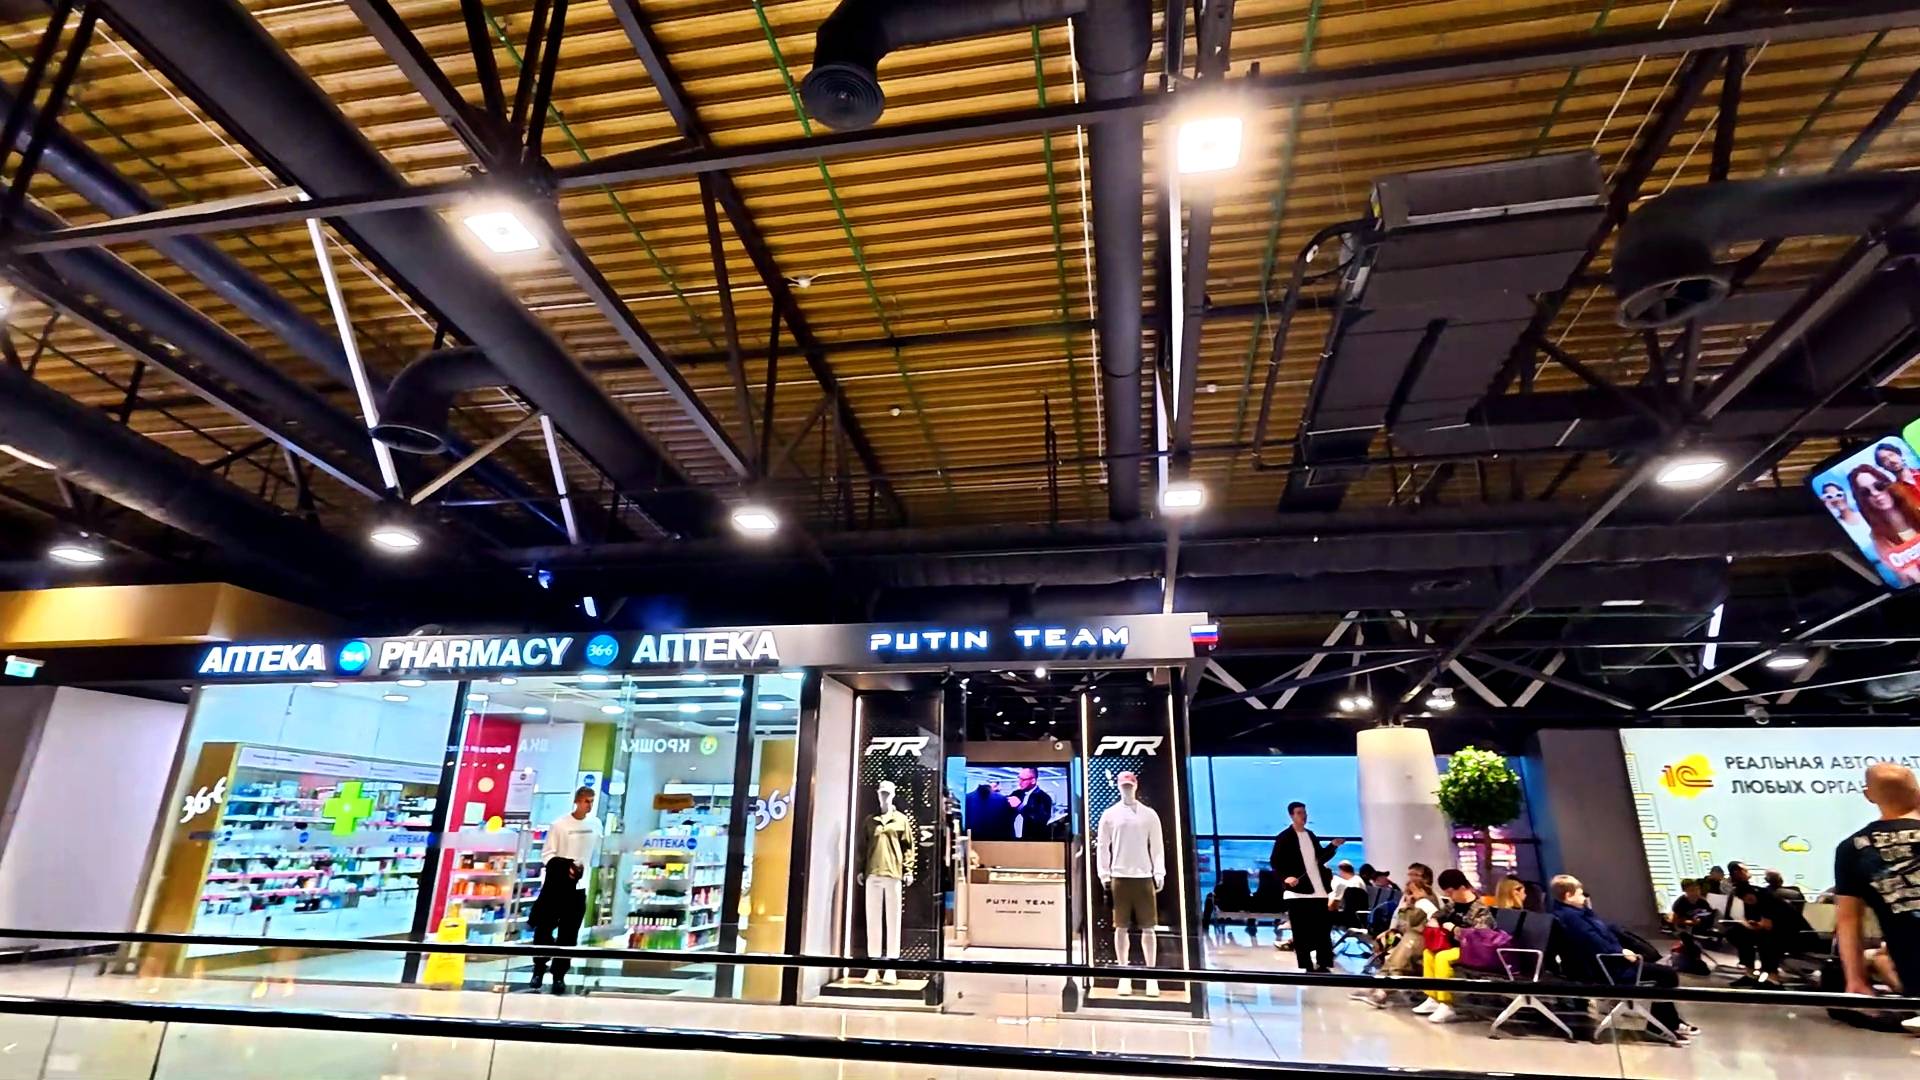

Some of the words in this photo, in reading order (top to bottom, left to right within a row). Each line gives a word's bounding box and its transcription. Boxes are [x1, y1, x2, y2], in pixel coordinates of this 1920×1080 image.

[631, 631, 780, 663] АПТЕКА
[871, 630, 988, 650] PUTIN
[1014, 627, 1129, 647] TEAM
[199, 643, 326, 673] АПТЕКА
[378, 637, 574, 669] PHARMACY
[865, 737, 929, 756] PTR
[1094, 736, 1163, 756] PTR
[1725, 756, 1824, 769] РЕАЛЬНАЯ
[1732, 780, 1807, 794] ЛЮБЫХ
[643, 838, 685, 848] АПТЕКА
